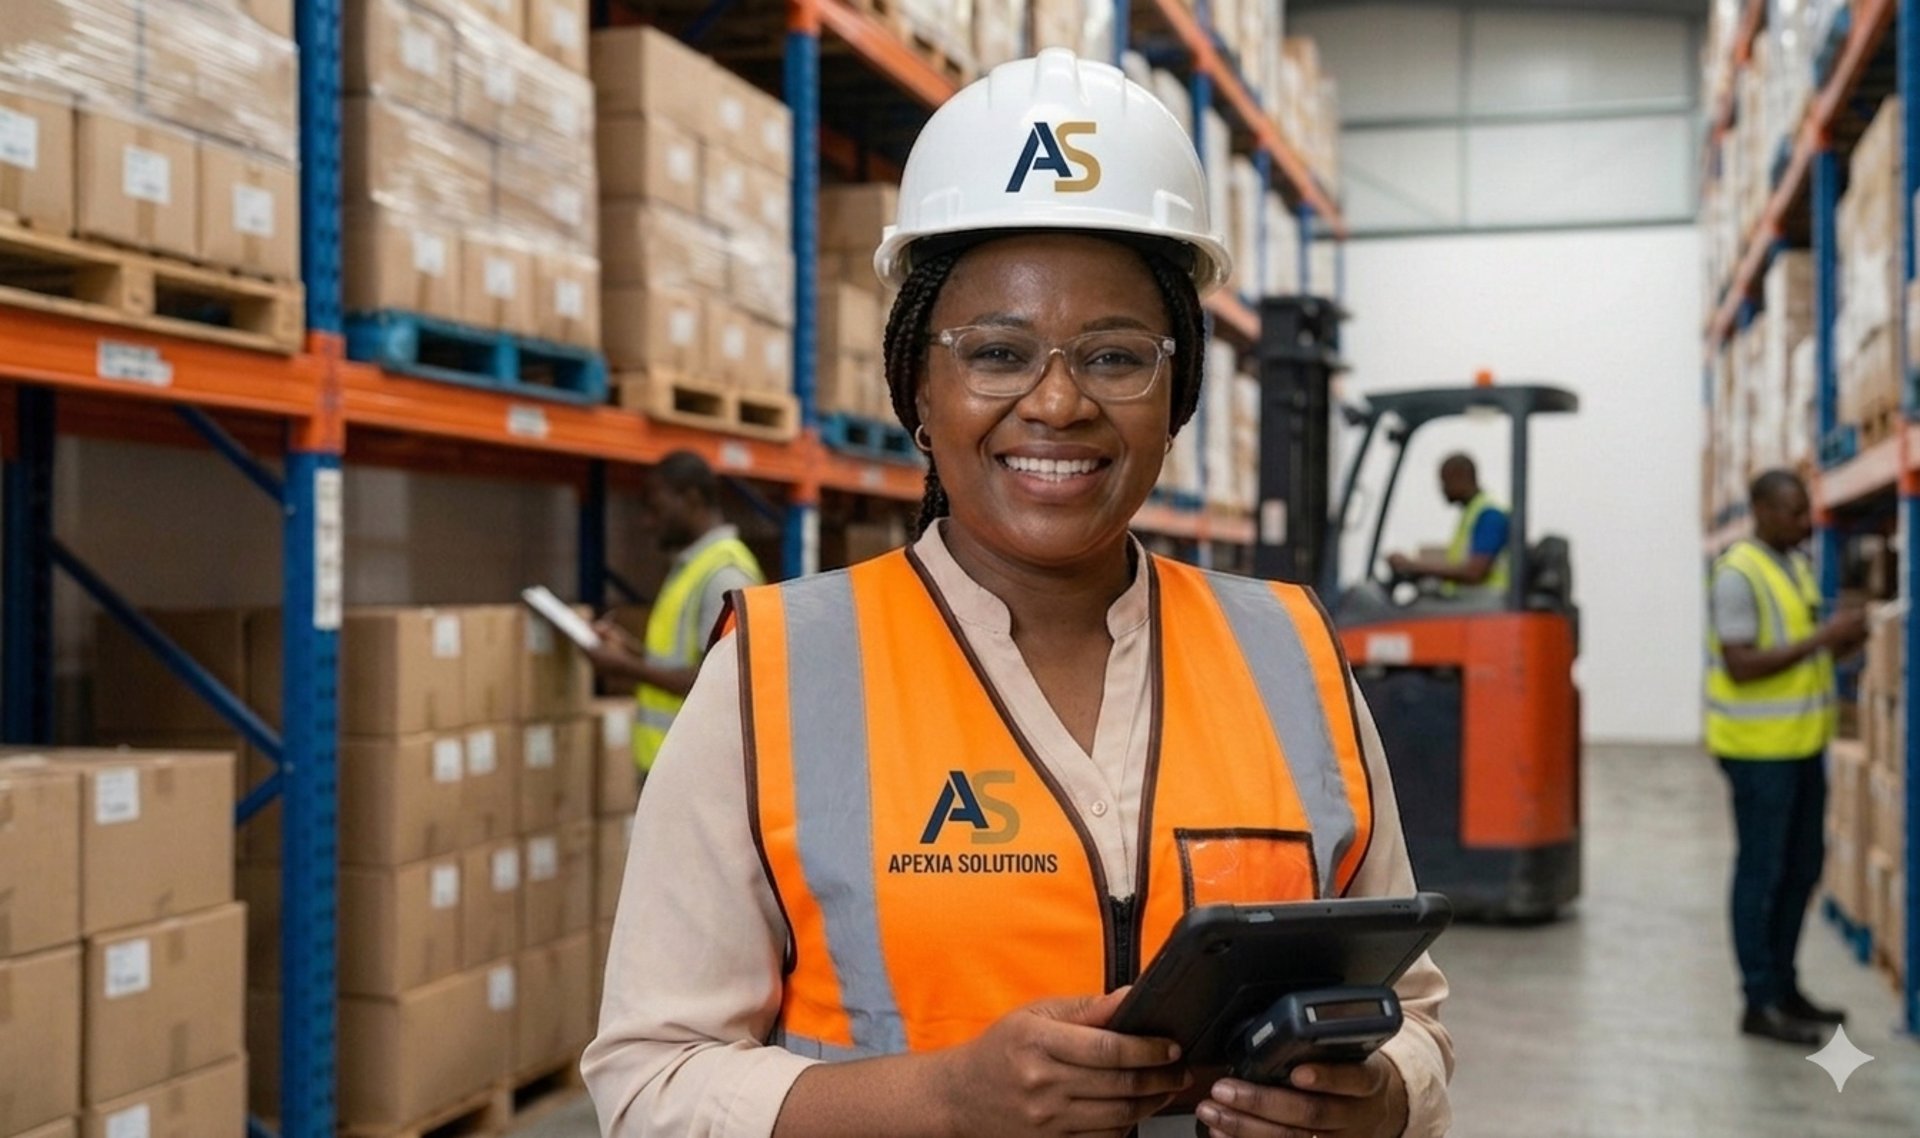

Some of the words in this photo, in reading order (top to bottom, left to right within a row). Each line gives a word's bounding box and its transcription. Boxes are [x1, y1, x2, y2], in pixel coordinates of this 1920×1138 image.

[1005, 121, 1101, 193] AS
[919, 770, 1021, 845] AS
[888, 853, 953, 873] APEXIA
[958, 853, 1058, 873] SOLUTIONS
